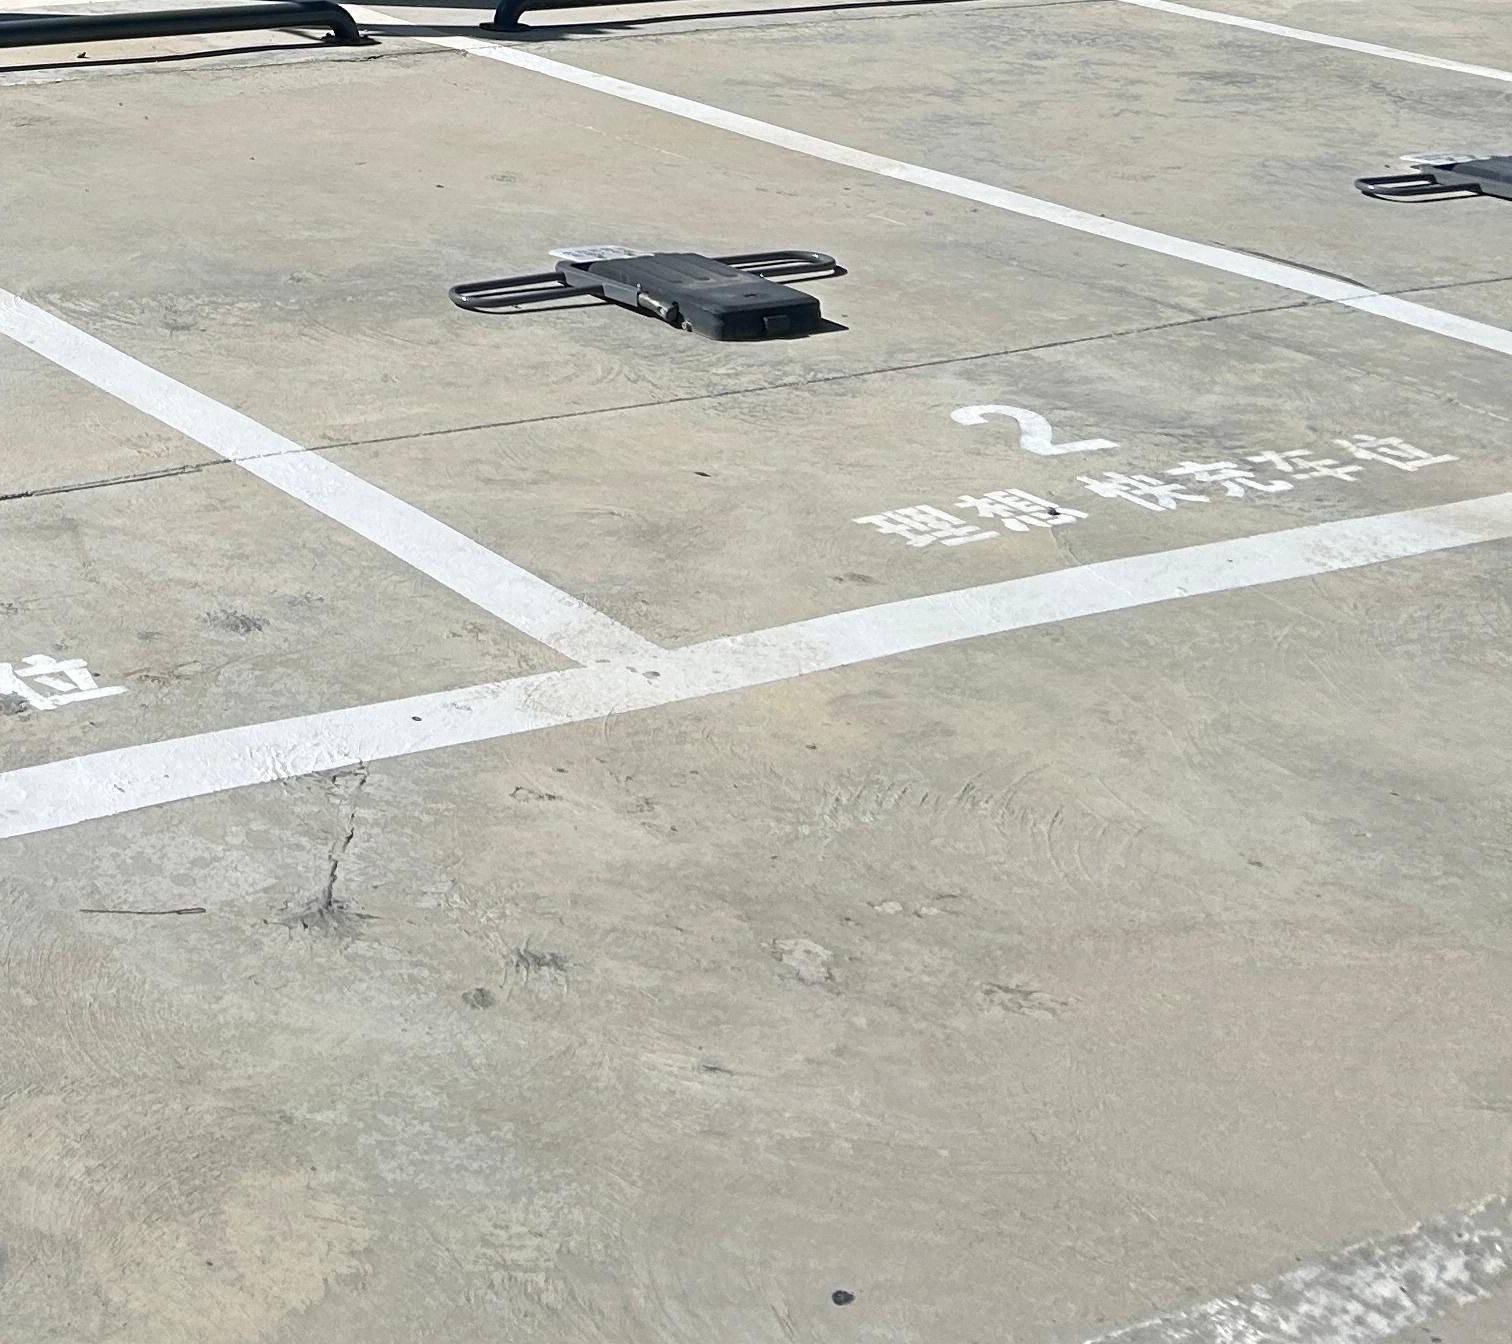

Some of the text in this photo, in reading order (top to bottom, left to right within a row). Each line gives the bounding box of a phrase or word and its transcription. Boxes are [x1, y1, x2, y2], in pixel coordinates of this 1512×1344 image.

[950, 404, 1120, 457] 2
[852, 432, 1459, 548] 理想 快充车位
